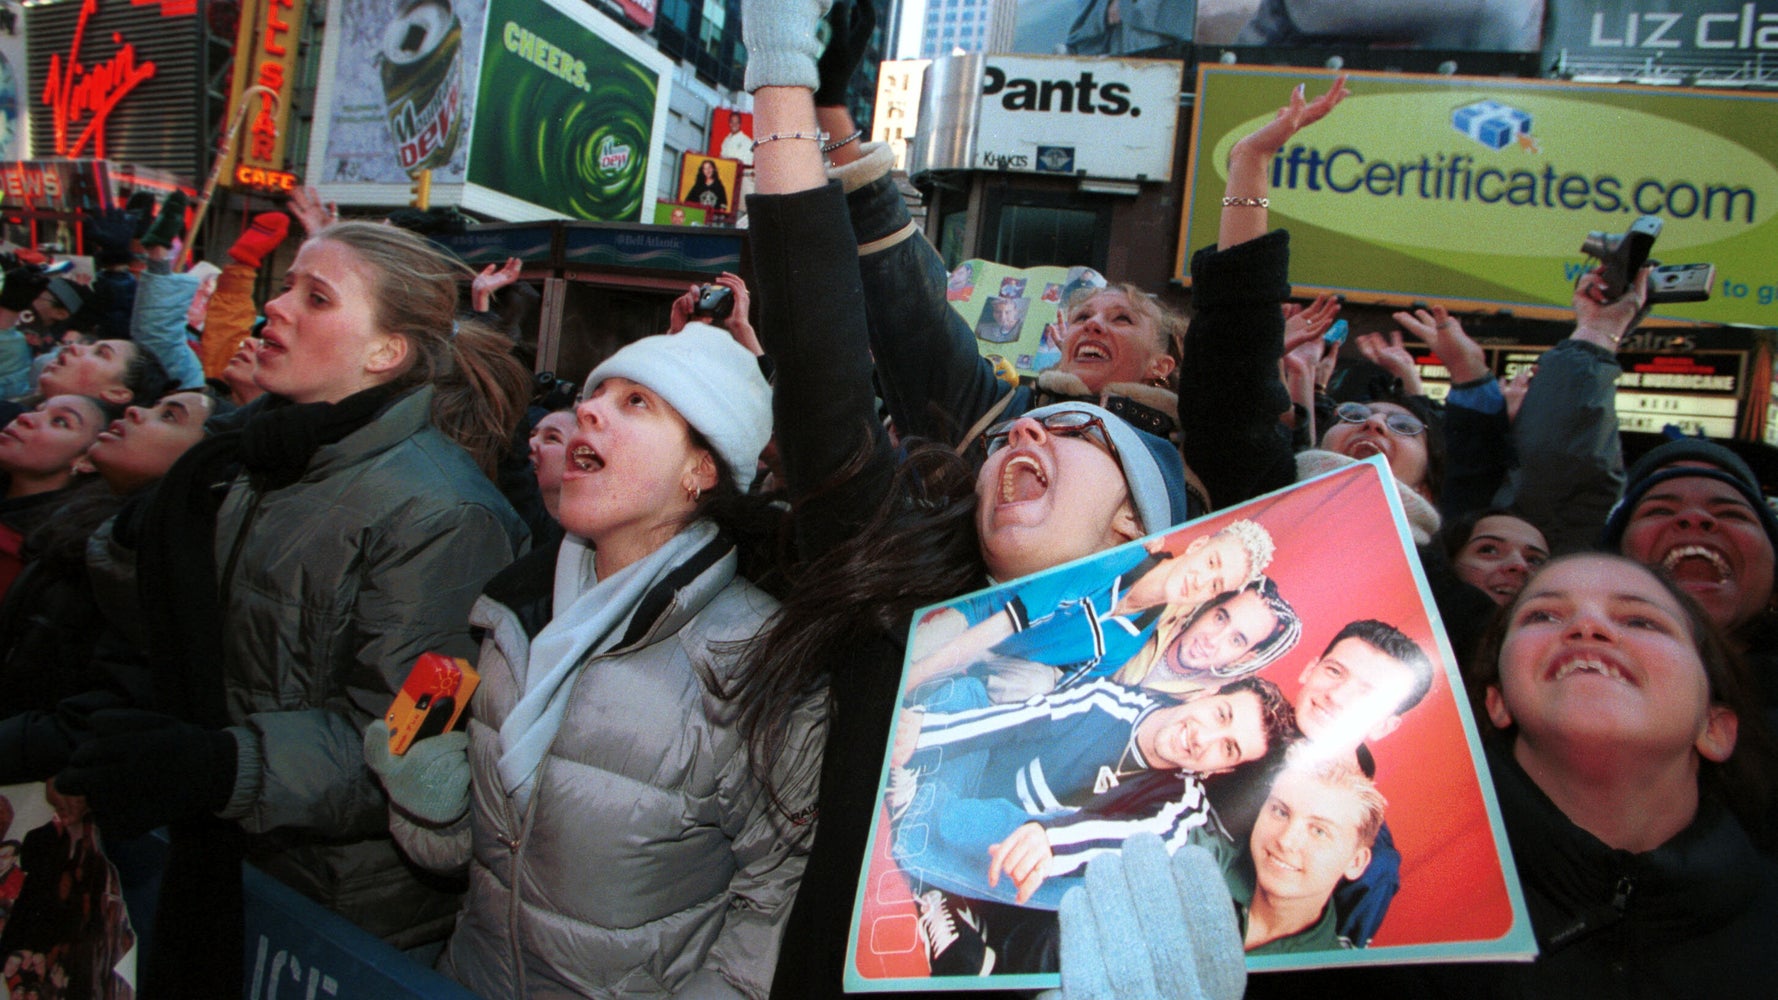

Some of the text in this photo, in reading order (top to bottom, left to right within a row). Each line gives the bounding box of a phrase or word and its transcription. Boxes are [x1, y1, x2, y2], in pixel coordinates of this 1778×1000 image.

[1590, 12, 1683, 47] LIZ
[504, 21, 591, 92] CHEERS.
[43, 0, 156, 159] Virgin
[252, 0, 293, 161] LL STAR
[982, 66, 1141, 118] Pants.
[0, 171, 61, 197] EWS
[237, 167, 295, 190] CAFE
[1268, 146, 1757, 224] iftCertificates.com
[645, 235, 681, 249] Atlantic
[1723, 279, 1778, 305] to g
